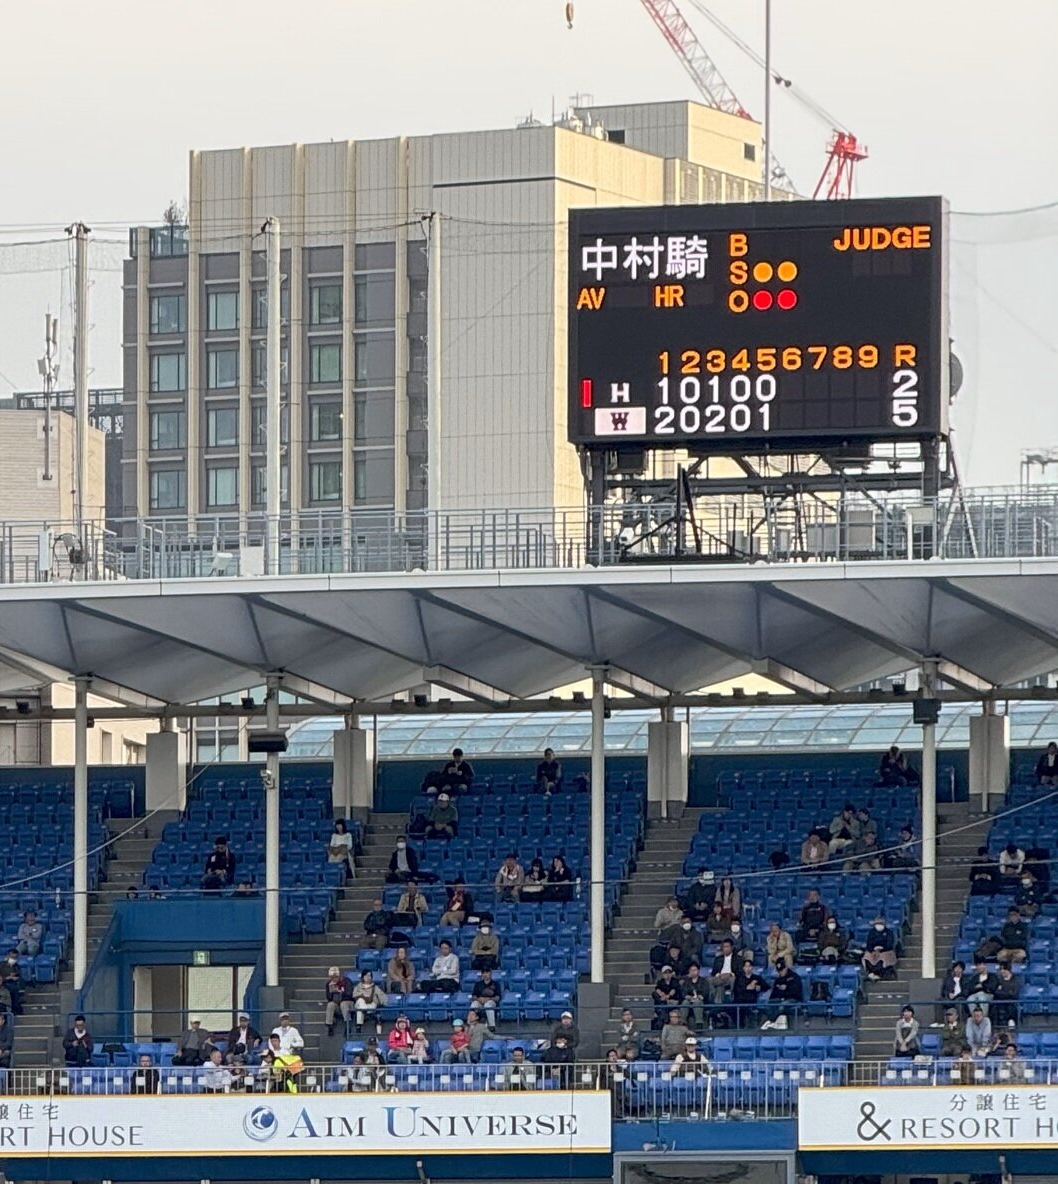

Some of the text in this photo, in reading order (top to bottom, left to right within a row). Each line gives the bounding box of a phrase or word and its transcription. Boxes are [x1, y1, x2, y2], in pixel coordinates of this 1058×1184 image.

[730, 233, 748, 256] B
[834, 226, 931, 250] JUDGE
[581, 235, 709, 281] 中村騎
[730, 261, 748, 285] S
[577, 285, 684, 309] AV HR
[894, 345, 917, 367] R
[611, 383, 630, 403] H
[893, 369, 918, 397] 2
[892, 399, 918, 426] 5
[950, 1093, 1047, 1112] 分譲住宅
[287, 1106, 578, 1138] AIM UNIVERSE
[857, 1101, 1058, 1141] & RESORT H
[48, 1125, 144, 1147] HOUSE
